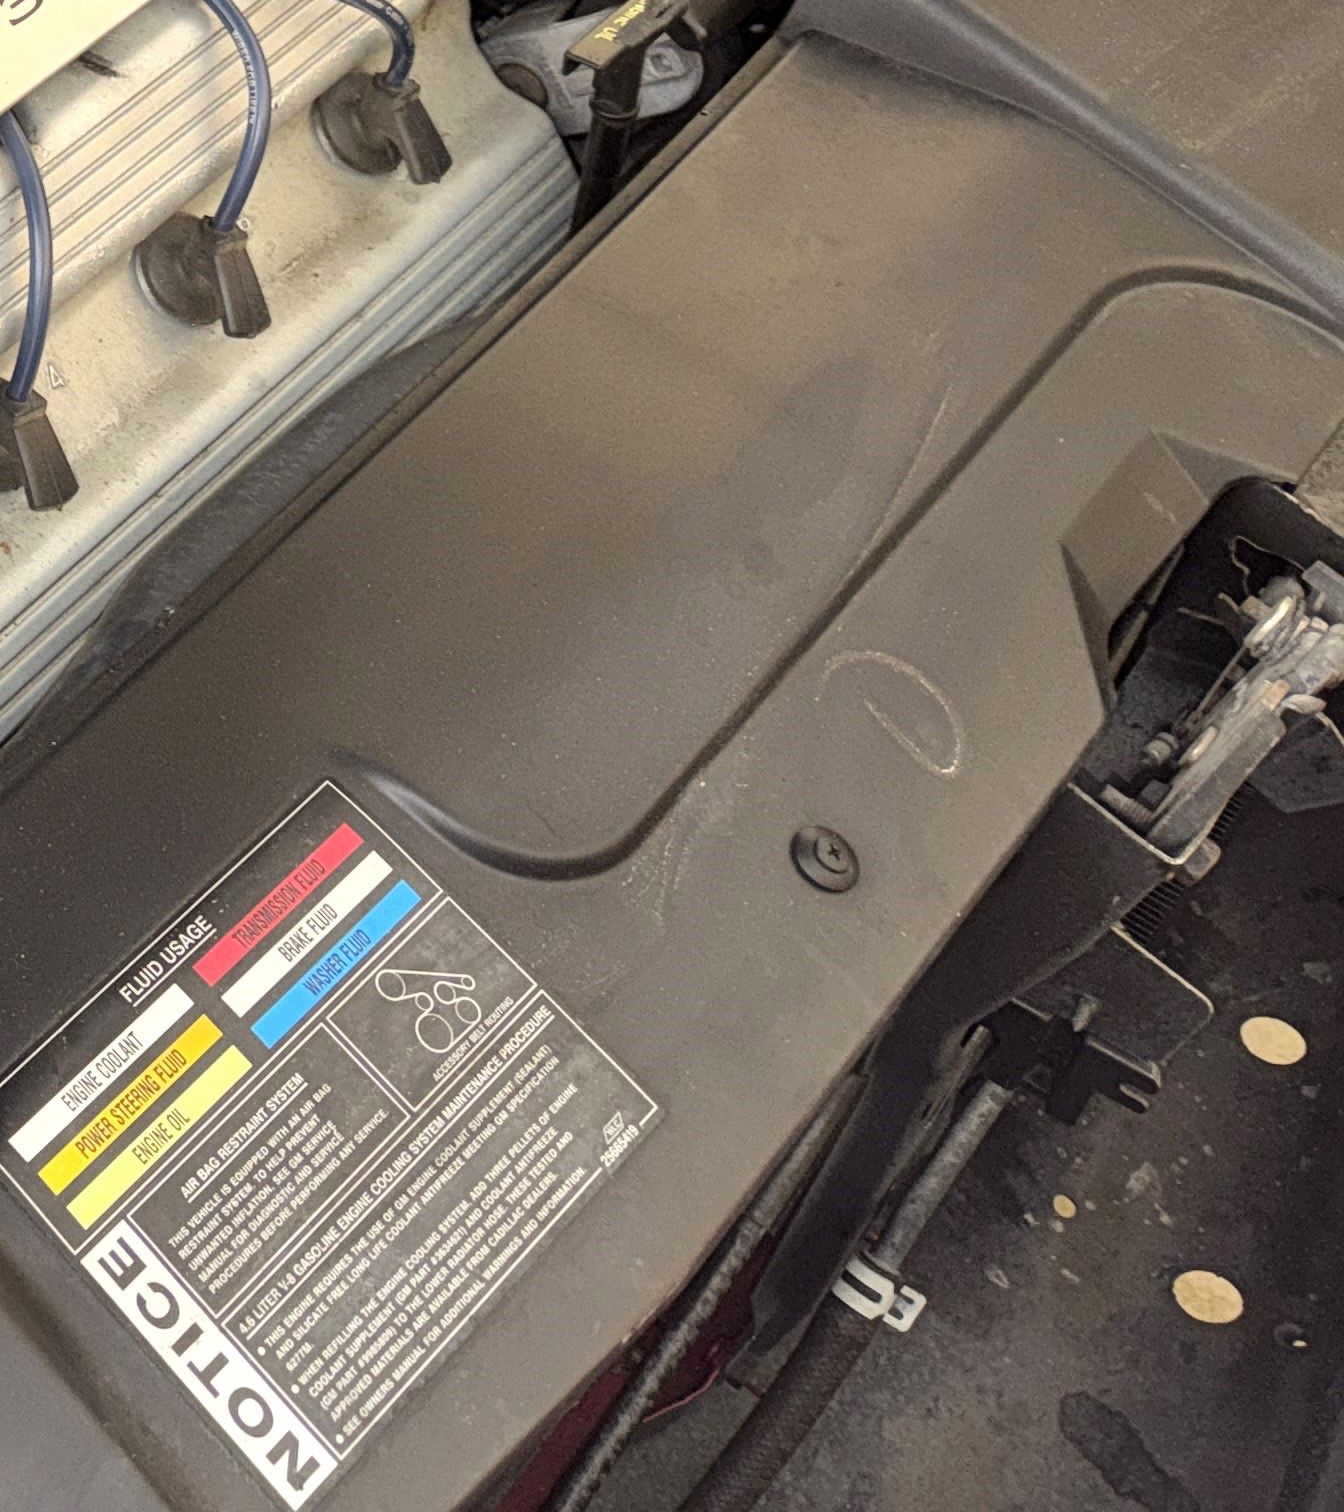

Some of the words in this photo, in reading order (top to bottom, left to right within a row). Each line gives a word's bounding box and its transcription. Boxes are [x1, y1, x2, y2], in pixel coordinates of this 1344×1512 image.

[118, 958, 166, 1005] FLUID
[159, 913, 214, 966] USAGE
[230, 880, 302, 950] TRANSMISSION
[292, 856, 328, 890] FLUID
[275, 926, 314, 964] BRAKE
[305, 901, 340, 936] FLUID
[301, 951, 347, 998] WASHER
[338, 926, 373, 961] FLUID
[59, 1070, 103, 1114] ENGINE
[94, 1029, 146, 1080] COOLANT
[73, 1116, 117, 1161] POWER
[108, 1073, 161, 1126] STEERING
[152, 1045, 190, 1083] FLUID
[430, 1039, 473, 1083] ACCESSORY
[467, 1023, 487, 1044] BELT
[482, 994, 515, 1028] ROUTING
[129, 1121, 173, 1167] ENGINE
[164, 1103, 191, 1132] OIL
[166, 1225, 190, 1251] THIS
[186, 1192, 223, 1230] VEHICLE
[219, 1182, 232, 1197] IS
[228, 1144, 270, 1187] EQUIPPED
[266, 1124, 290, 1149] WITH
[285, 1112, 302, 1129] AN
[297, 1098, 315, 1117] AIR
[311, 1080, 333, 1103] BAG
[176, 1212, 224, 1262] RESTRAINT
[252, 1167, 268, 1184] TO
[264, 1146, 288, 1172] HELP
[284, 1112, 323, 1152] PREVENT
[177, 1176, 201, 1200] AIR
[195, 1155, 221, 1182] BAG
[216, 1106, 270, 1161] RESTRAINT
[264, 1070, 306, 1112] SYSTEM
[186, 1223, 234, 1273] UNWANTED
[271, 1165, 291, 1186] SEE
[287, 1151, 304, 1170] GM
[300, 1117, 337, 1156] SERVICE
[235, 1314, 257, 1337] 4.6
[251, 1287, 283, 1320] LITER
[291, 1225, 341, 1278] GASOLINE
[336, 1190, 374, 1231] ENGINE
[368, 1149, 413, 1197] COOLING
[407, 1114, 446, 1156] SYSTEM
[440, 1054, 503, 1121] MAINTENANCE
[497, 1002, 553, 1060] PROCEDURE
[262, 1324, 287, 1350] THIS
[282, 1293, 316, 1329] ENGINE
[311, 1252, 354, 1298] REQUIRES
[350, 1236, 370, 1257] THE
[365, 1219, 386, 1241] USE
[381, 1207, 397, 1224] OF
[392, 1192, 411, 1212] GM
[405, 1164, 438, 1198] ENGINE
[433, 1128, 472, 1169] COOLANT
[467, 1079, 517, 1133] SUPPLEMENT
[512, 1041, 553, 1085] (SEALANT)
[196, 1245, 234, 1285] MANUAL
[229, 1227, 251, 1250] FOR
[246, 1180, 296, 1232] DIAGNOSTIC
[292, 1163, 313, 1186] AND
[309, 1129, 346, 1168] SERVICE
[206, 1236, 263, 1297] PROCEDURES
[259, 1205, 293, 1242] BEFORE
[289, 1155, 341, 1210] PERFORMING
[336, 1139, 357, 1161] ANY
[95, 1235, 324, 1494] NOTICE
